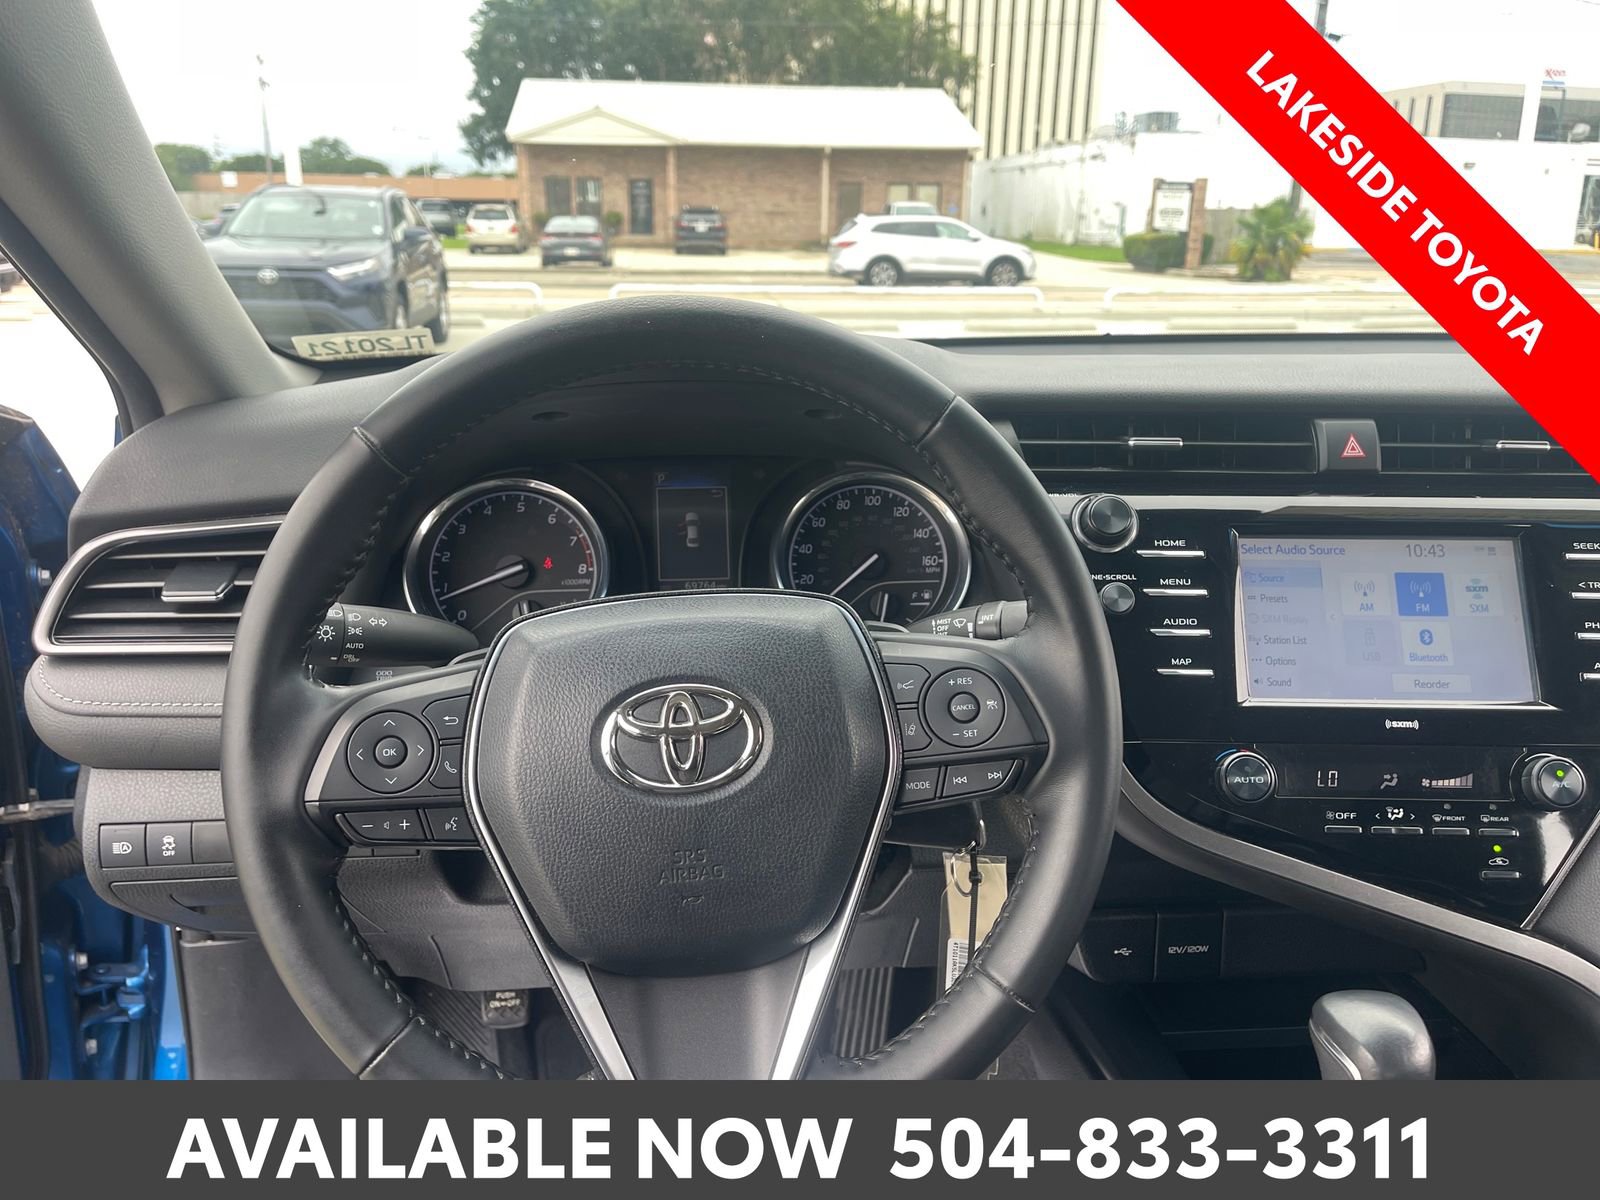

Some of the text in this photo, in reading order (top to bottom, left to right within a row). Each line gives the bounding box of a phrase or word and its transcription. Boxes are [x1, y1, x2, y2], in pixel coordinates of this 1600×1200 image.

[836, 500, 850, 510] 80
[864, 496, 881, 506] 100
[484, 504, 492, 515] 4
[516, 502, 525, 512] 5
[893, 506, 910, 518] 120
[548, 514, 556, 524] 6
[812, 517, 826, 528] 60
[458, 524, 466, 534] 3
[914, 528, 930, 539] 140
[570, 536, 578, 546] 7
[1154, 539, 1186, 547] HOME
[798, 544, 813, 554] 40
[1240, 544, 1346, 556] Select Audio Source
[1406, 544, 1446, 558] 10:43
[442, 552, 450, 562] 2
[922, 556, 938, 566] 160
[578, 564, 587, 574] 8
[800, 574, 814, 584] 20
[1258, 574, 1285, 582] Source
[1260, 594, 1288, 603] Presets
[1360, 603, 1374, 612] AM
[1416, 604, 1430, 612] FM
[1470, 604, 1489, 612] SXM
[457, 610, 467, 621] 0
[1264, 636, 1307, 645] Station List
[1266, 656, 1296, 667] Options
[1409, 653, 1448, 662] Bluetooth
[957, 677, 972, 686] RES
[1267, 678, 1292, 686] Sound
[1414, 680, 1450, 688] Reorder
[952, 704, 976, 712] CANCEL
[963, 730, 978, 738] SET
[382, 748, 397, 757] OK
[906, 780, 931, 790] MODE
[1234, 776, 1264, 784] AUTO
[660, 864, 724, 885] AIRBAG
[1168, 946, 1209, 954] 12V/120W
